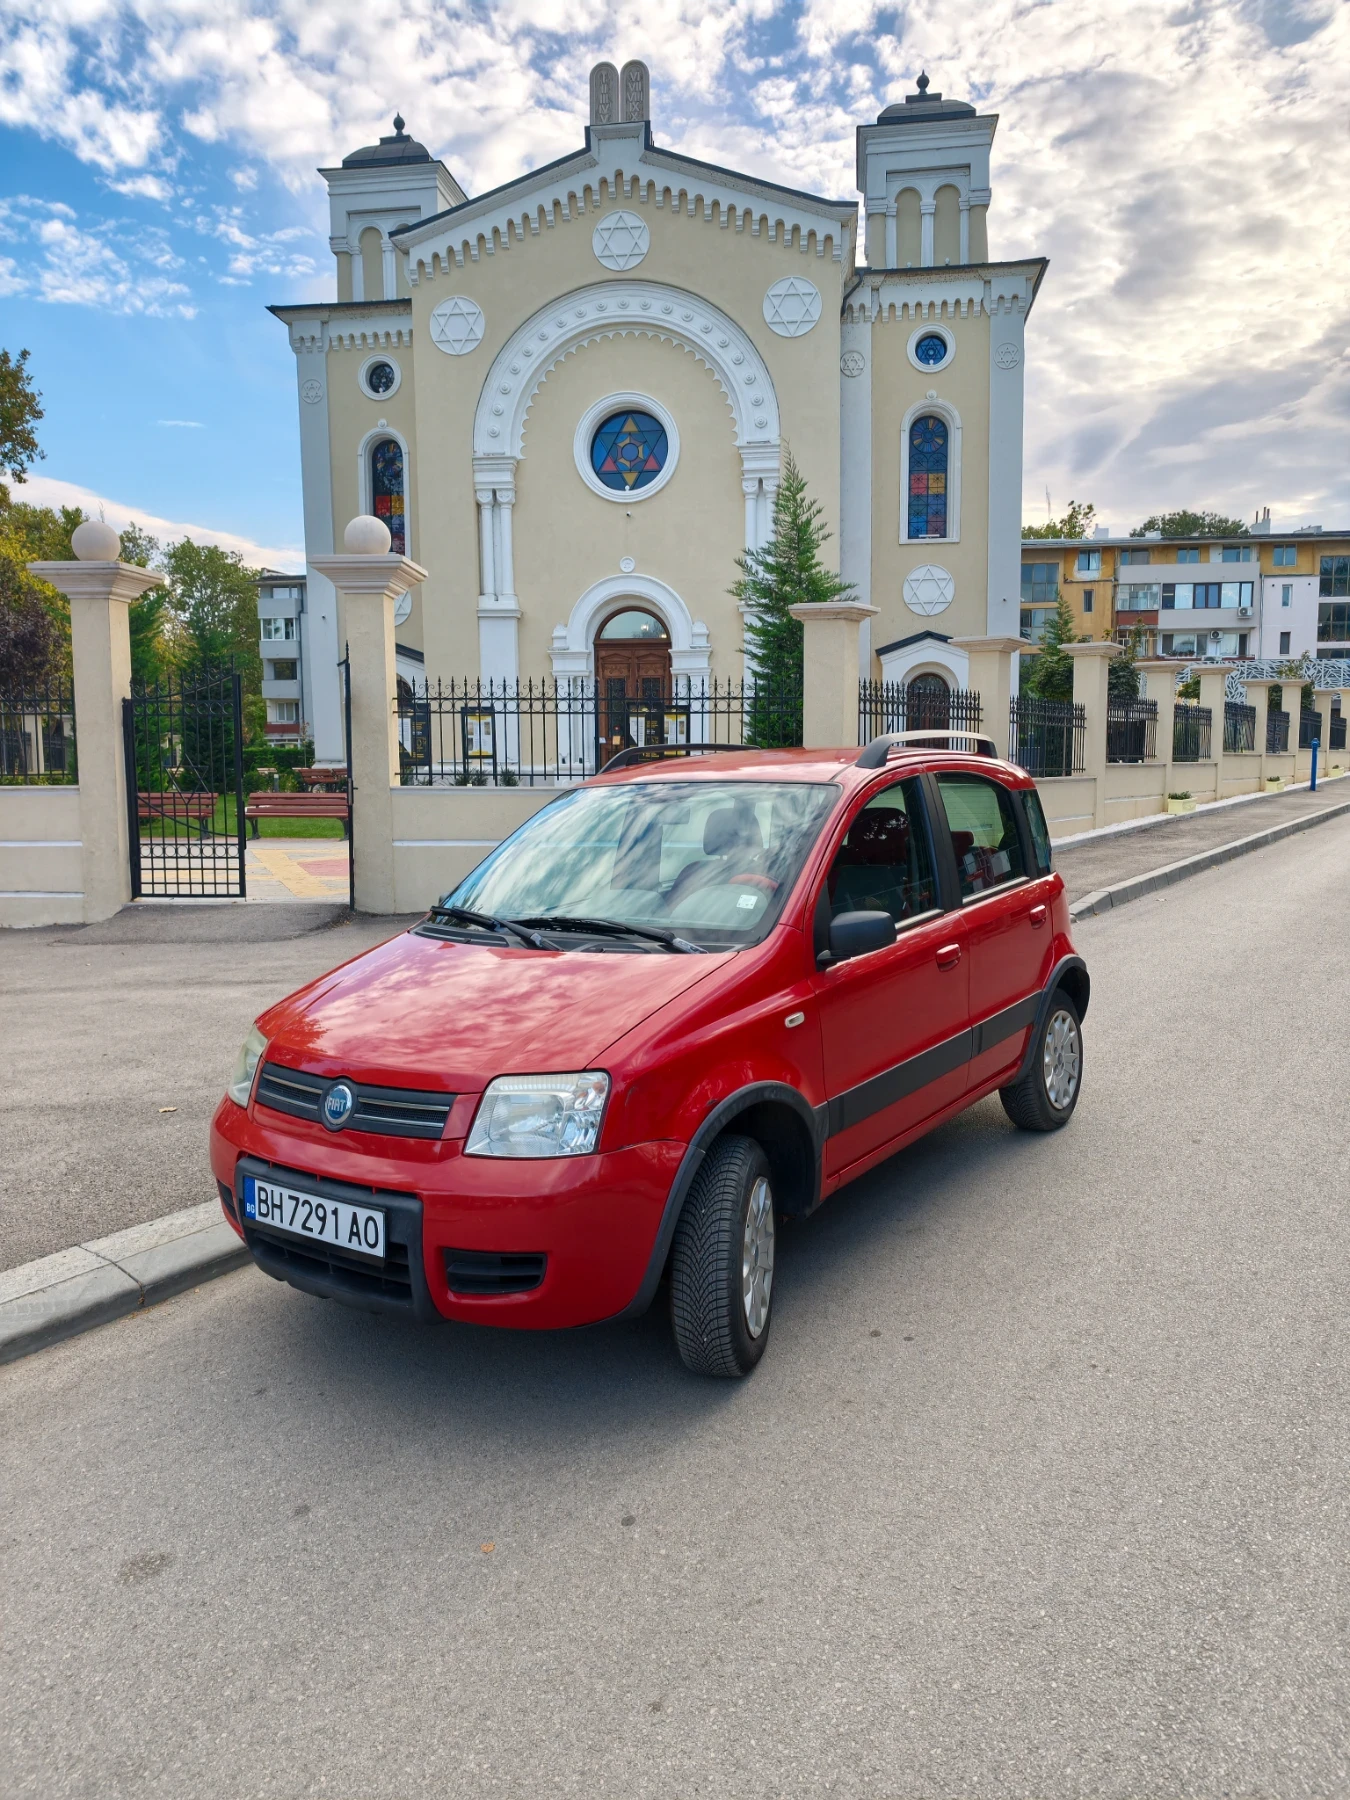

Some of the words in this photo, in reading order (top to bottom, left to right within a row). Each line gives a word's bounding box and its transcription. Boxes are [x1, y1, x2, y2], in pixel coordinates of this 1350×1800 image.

[630, 71, 640, 81] VI
[601, 83, 607, 93] II
[628, 81, 641, 91] VII
[600, 93, 609, 104] III
[627, 91, 643, 101] VIII
[599, 104, 610, 114] IV
[629, 102, 640, 112] IX
[327, 1097, 346, 1112] FIAT
[246, 1202, 255, 1214] BG
